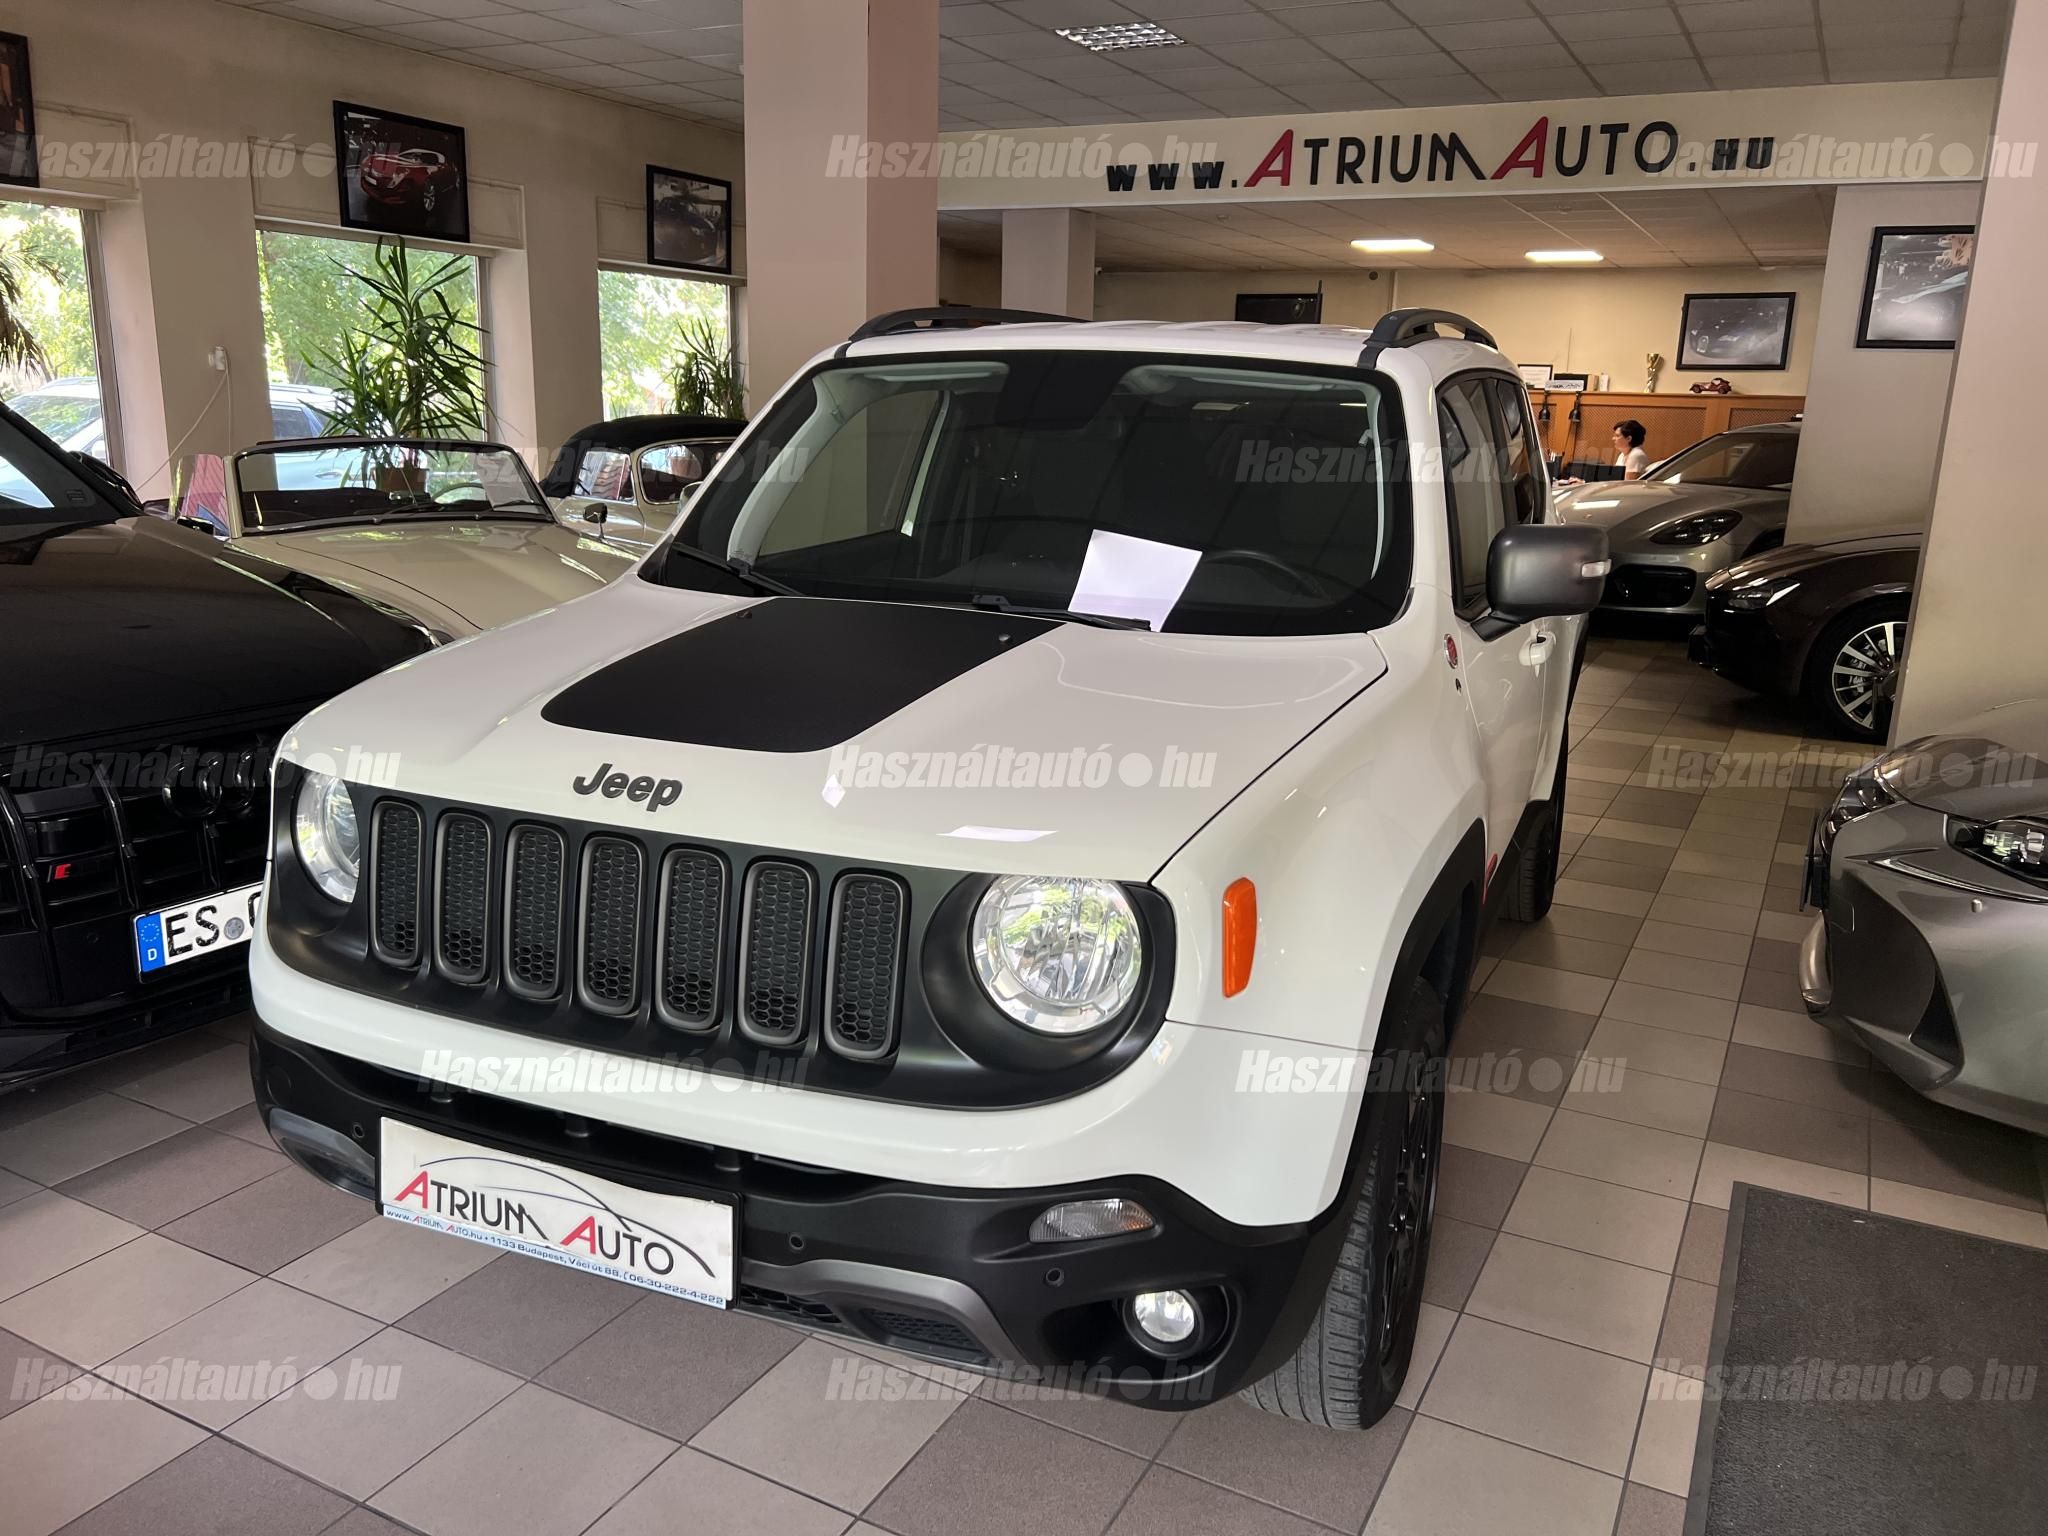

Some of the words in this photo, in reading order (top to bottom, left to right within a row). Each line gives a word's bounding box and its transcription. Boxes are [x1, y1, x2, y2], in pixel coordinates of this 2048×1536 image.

[573, 763, 683, 812] Jeep
[147, 948, 158, 961] D
[394, 1170, 549, 1240] ATRIUM
[560, 1215, 674, 1275] AUTO
[490, 1236, 515, 1249] 1133
[518, 1244, 567, 1263] Budapest,
